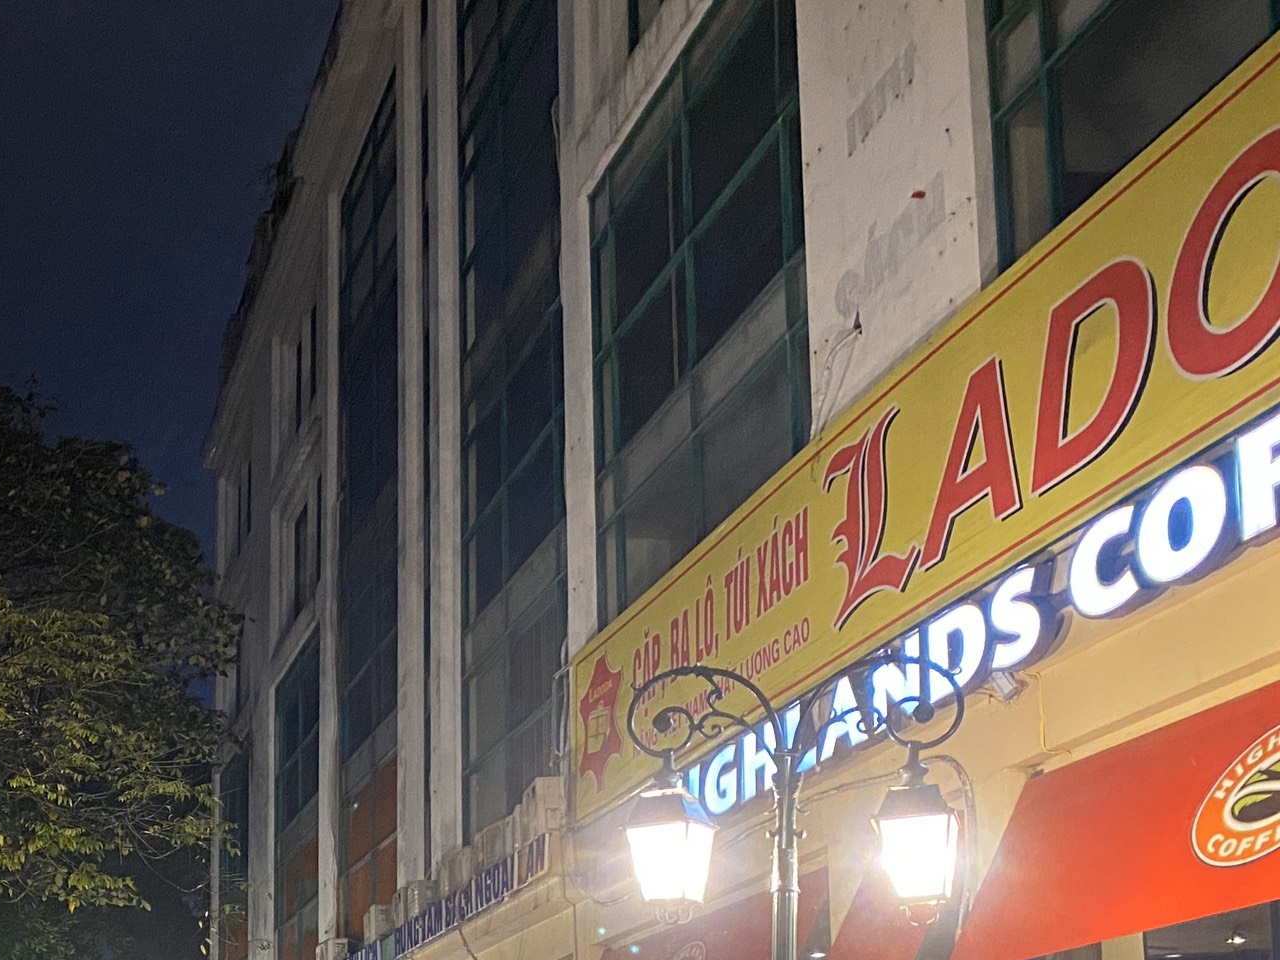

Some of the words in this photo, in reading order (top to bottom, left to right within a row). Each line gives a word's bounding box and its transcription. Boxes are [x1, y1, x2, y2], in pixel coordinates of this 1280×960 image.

[724, 546, 751, 641] TÚI
[756, 505, 810, 618] XÁCH
[783, 616, 810, 656] CAO
[677, 564, 1041, 816] IGHLANDS
